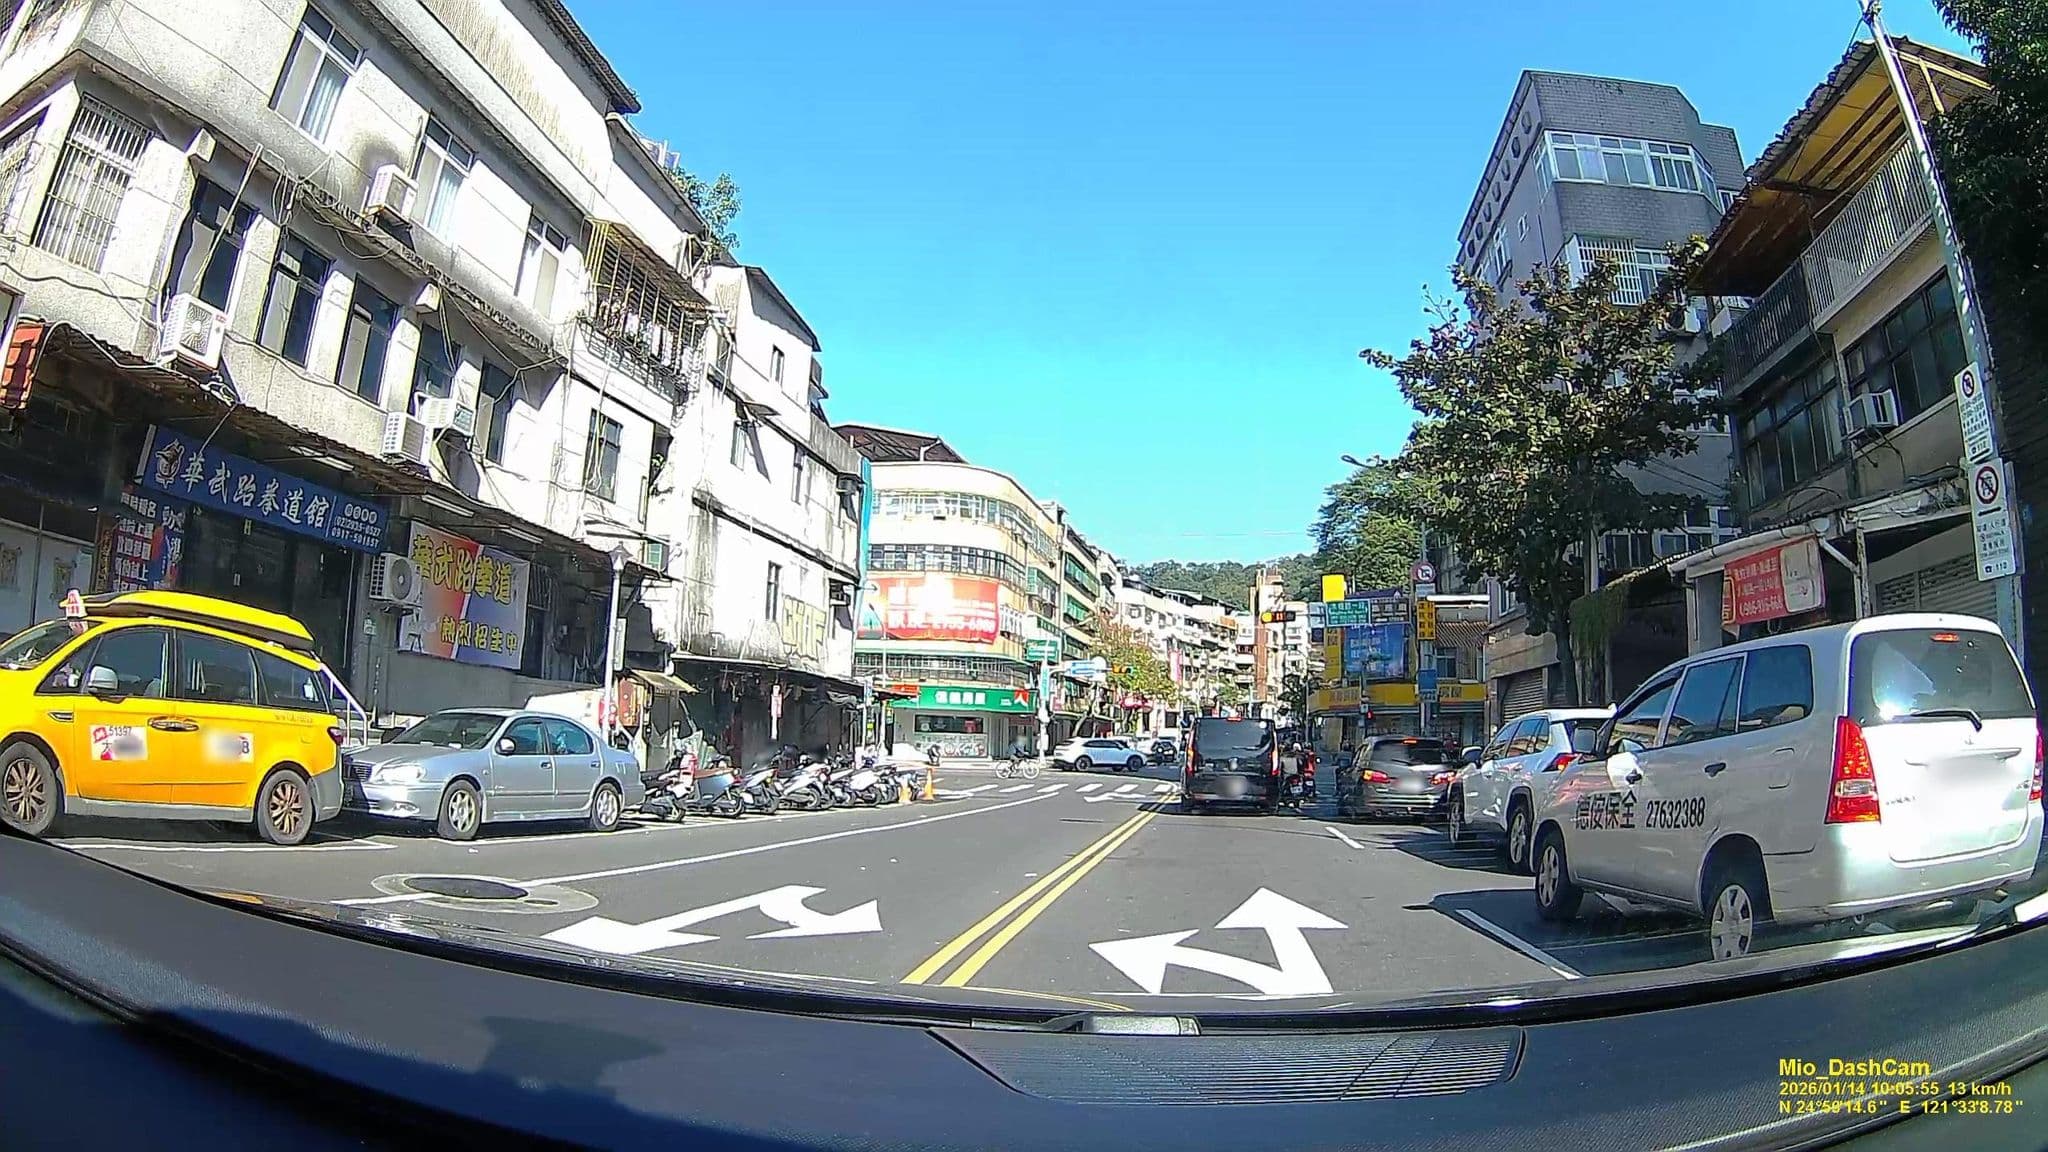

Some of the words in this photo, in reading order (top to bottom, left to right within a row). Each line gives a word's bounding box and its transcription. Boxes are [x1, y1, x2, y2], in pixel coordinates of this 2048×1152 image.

[181, 452, 331, 529] 華武跆拳道館
[412, 534, 512, 604] 華武跆拳道
[440, 615, 518, 655] 熱烈招生中
[109, 725, 132, 737] 51397
[1645, 796, 1706, 829] 27632388
